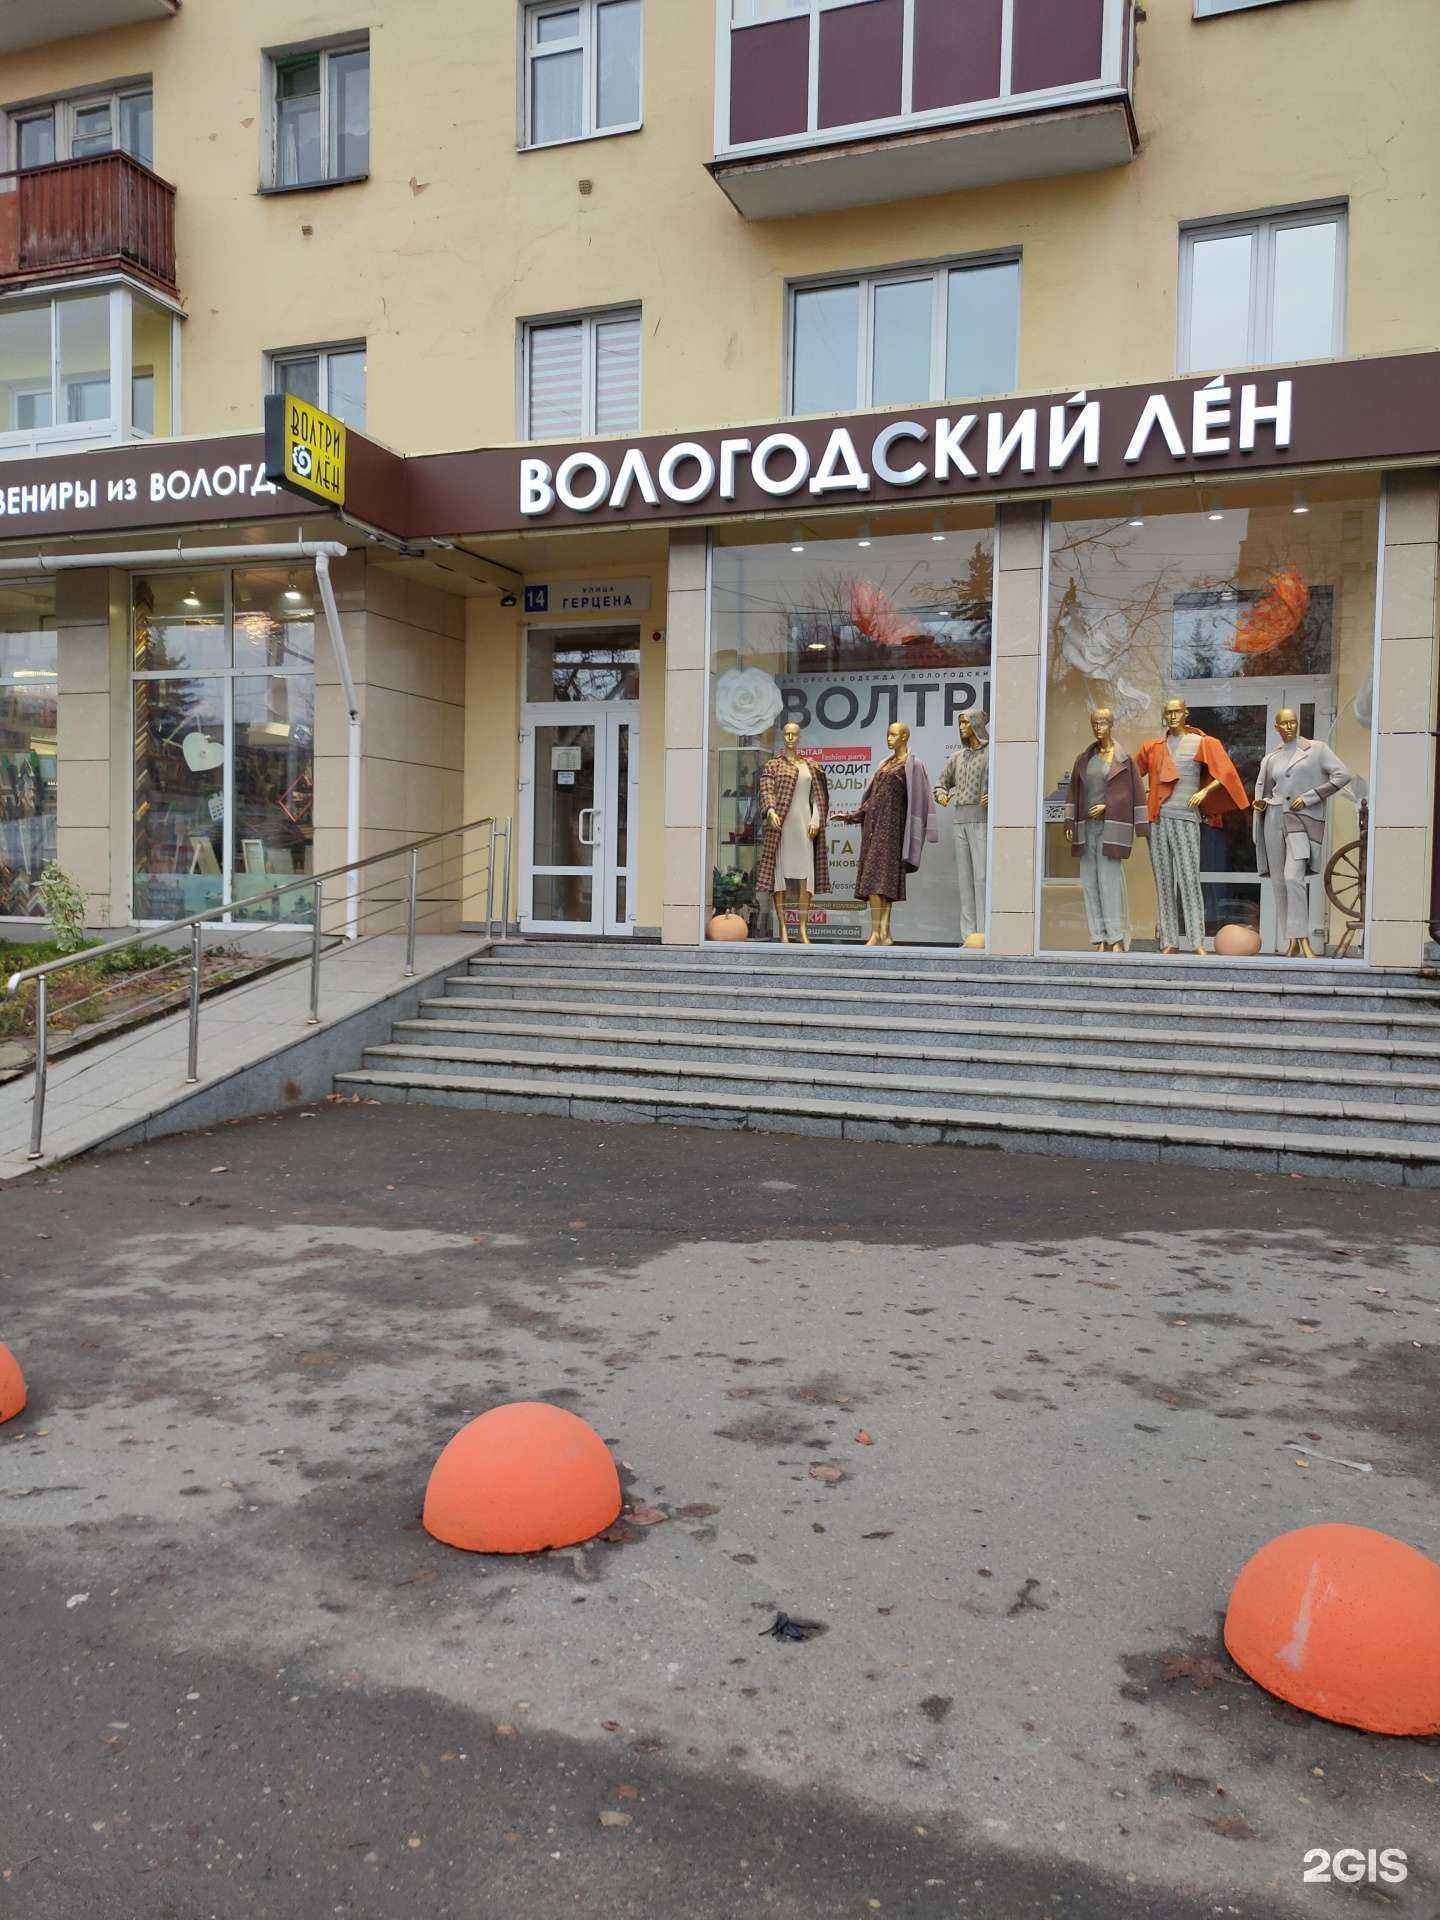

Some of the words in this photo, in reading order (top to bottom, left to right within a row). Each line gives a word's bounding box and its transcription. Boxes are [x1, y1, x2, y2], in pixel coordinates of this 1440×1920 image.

[291, 406, 340, 460] ВОЛТРИ
[520, 387, 1099, 516] ВОЛОГОДСКИЙ
[150, 462, 282, 501] ВОЛОГД
[526, 590, 546, 608] 14
[562, 595, 633, 609] ГЕРЦЕНА
